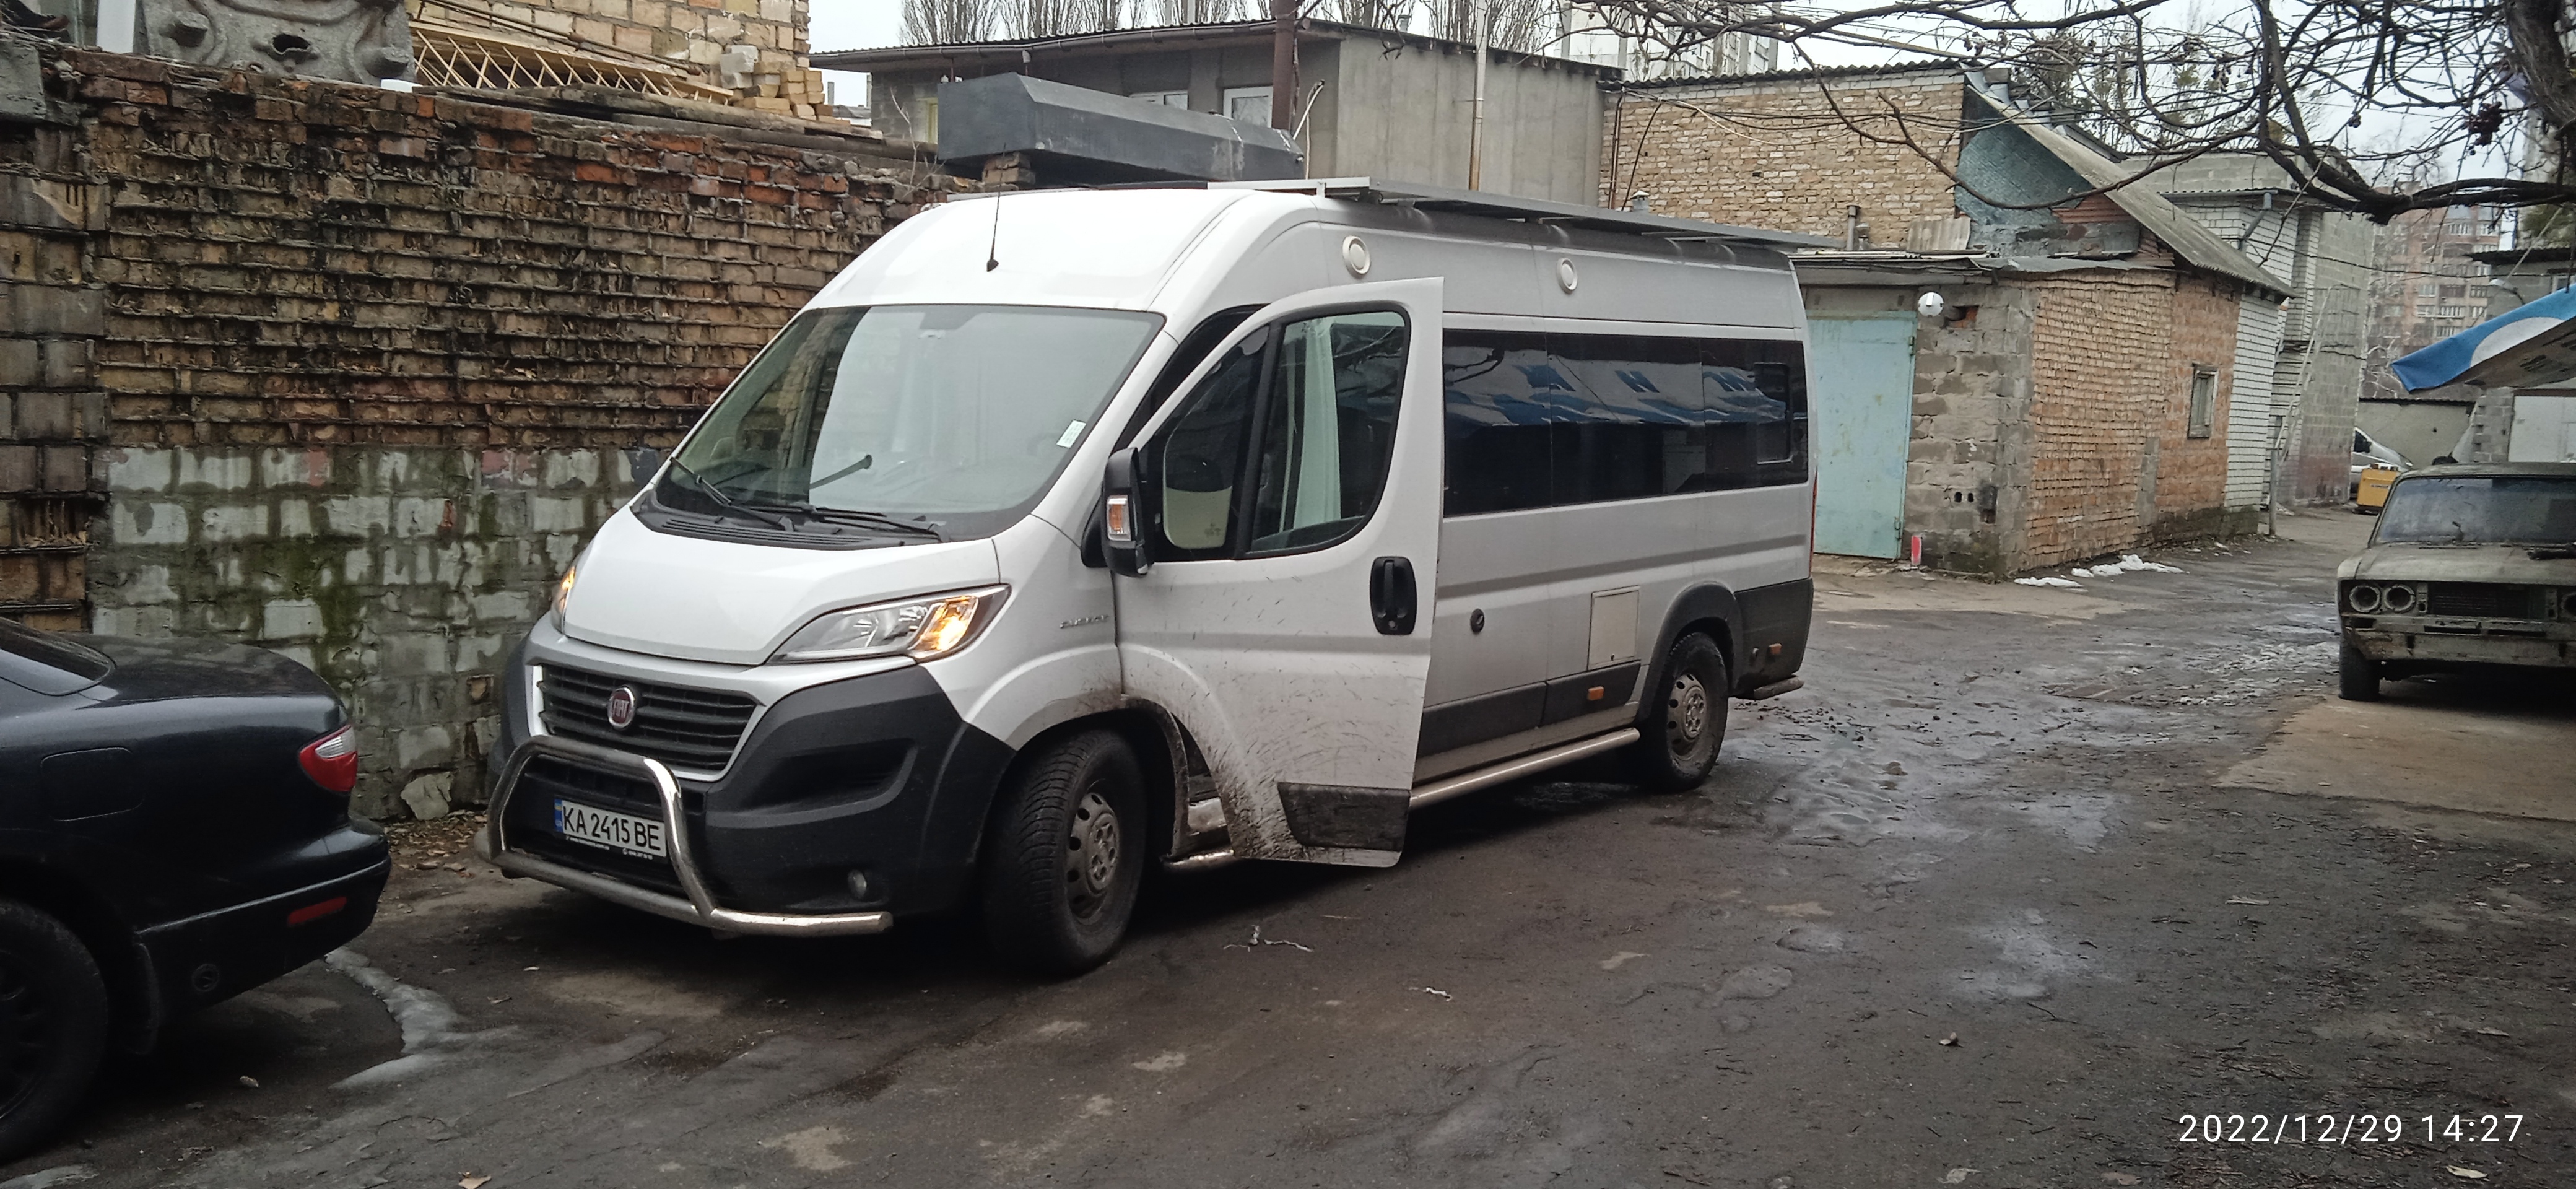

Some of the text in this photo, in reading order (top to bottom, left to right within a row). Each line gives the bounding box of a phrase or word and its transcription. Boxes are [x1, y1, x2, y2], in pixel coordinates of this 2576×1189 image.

[563, 806, 587, 835] KA
[591, 812, 630, 843] 2415
[634, 821, 661, 851] BE
